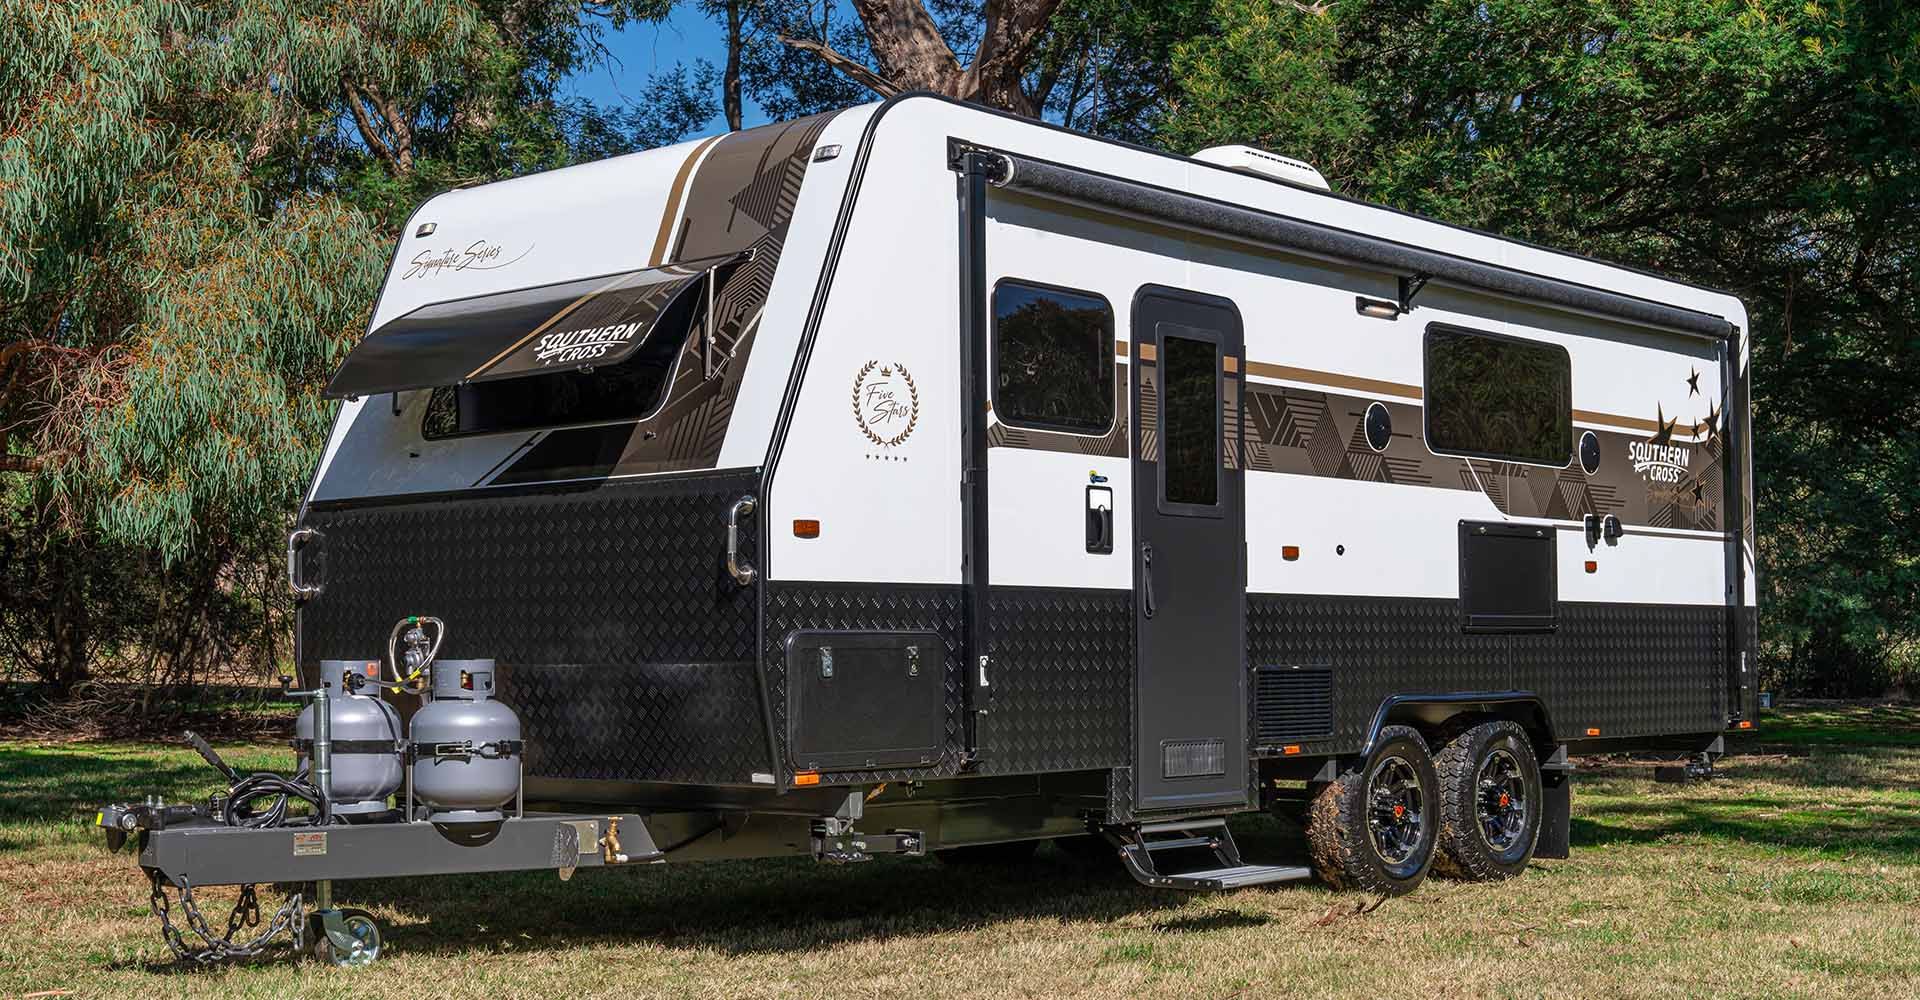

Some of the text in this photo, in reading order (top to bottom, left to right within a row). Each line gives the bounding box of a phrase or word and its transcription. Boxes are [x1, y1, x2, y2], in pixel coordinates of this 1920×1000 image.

[402, 239, 502, 280] Signature Series
[534, 321, 643, 352] SOUTHERN
[558, 343, 611, 363] CROSS
[866, 382, 895, 407] Five
[869, 399, 910, 425] Stars
[1628, 440, 1690, 467] SOUTHERN
[1650, 465, 1680, 483] CROSS
